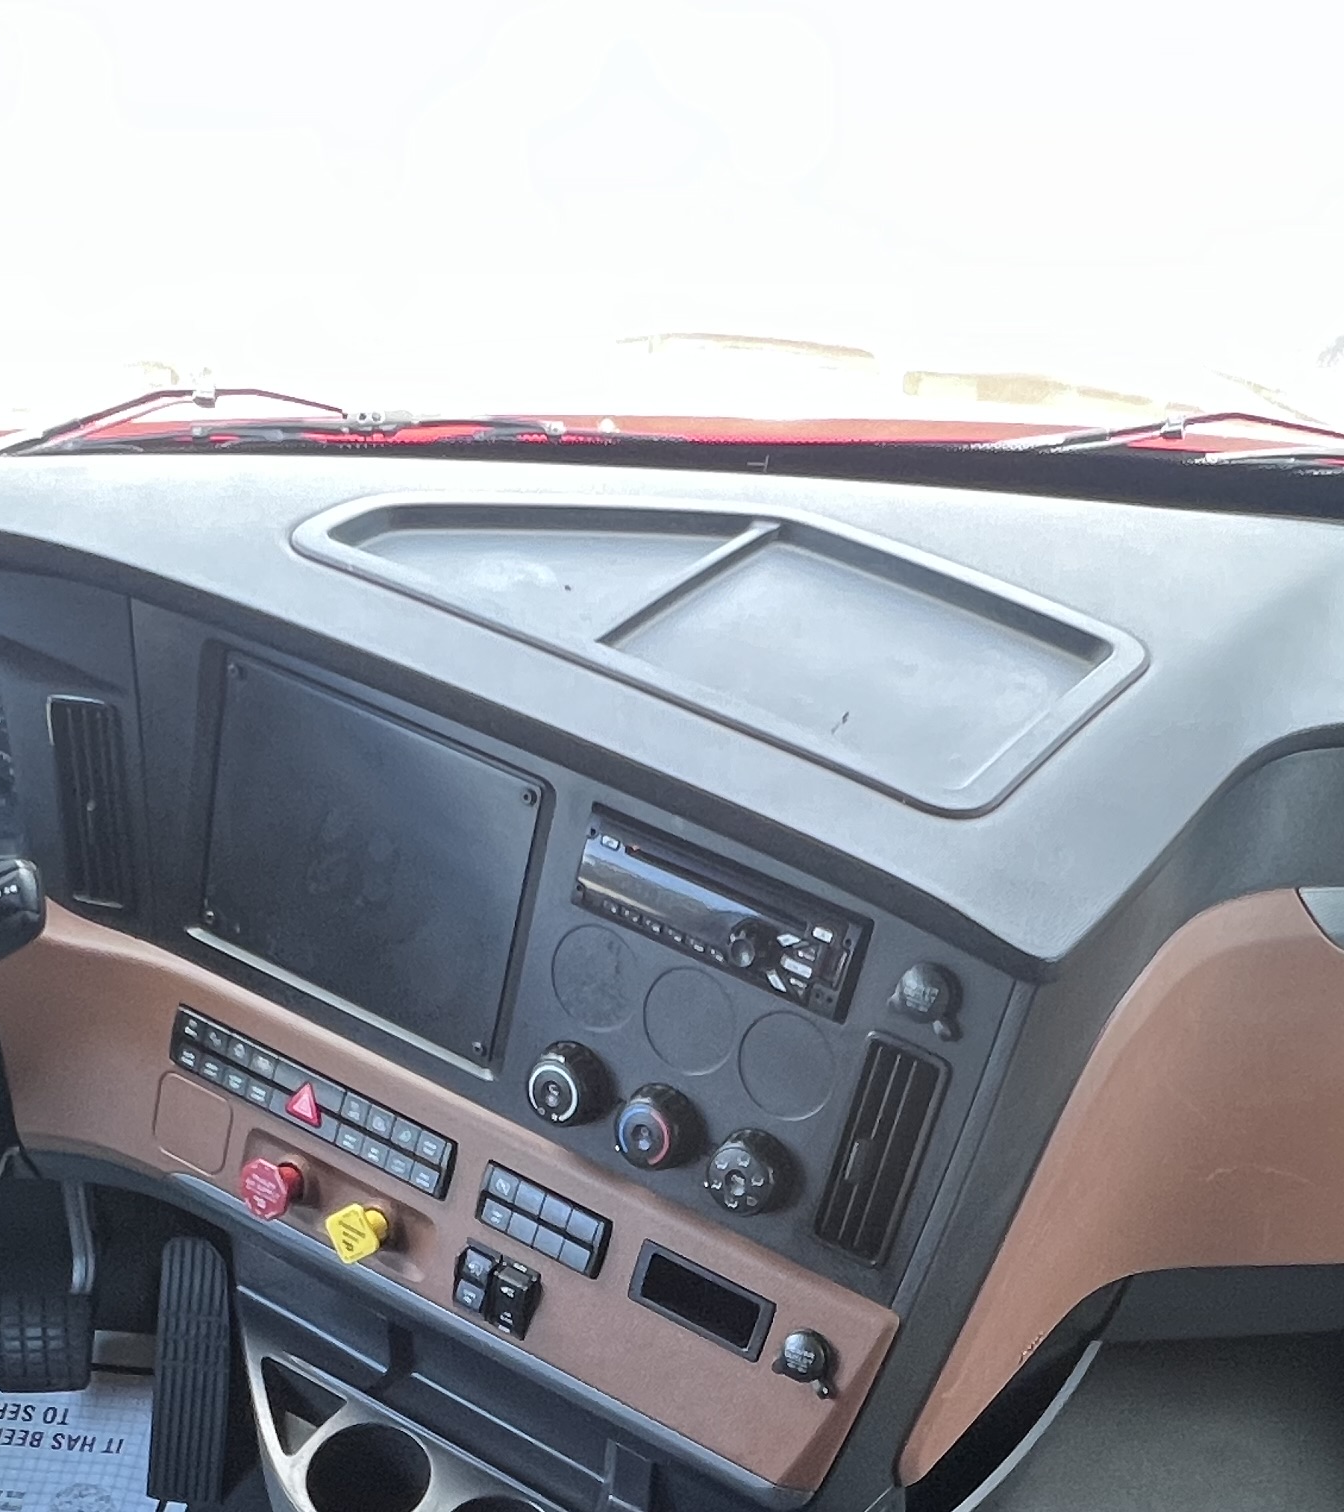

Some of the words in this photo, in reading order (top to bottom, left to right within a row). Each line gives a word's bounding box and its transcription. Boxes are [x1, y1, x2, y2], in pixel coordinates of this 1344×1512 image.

[42, 1406, 69, 1426] TO
[50, 1432, 97, 1454] HAS
[100, 1438, 124, 1454] IT
